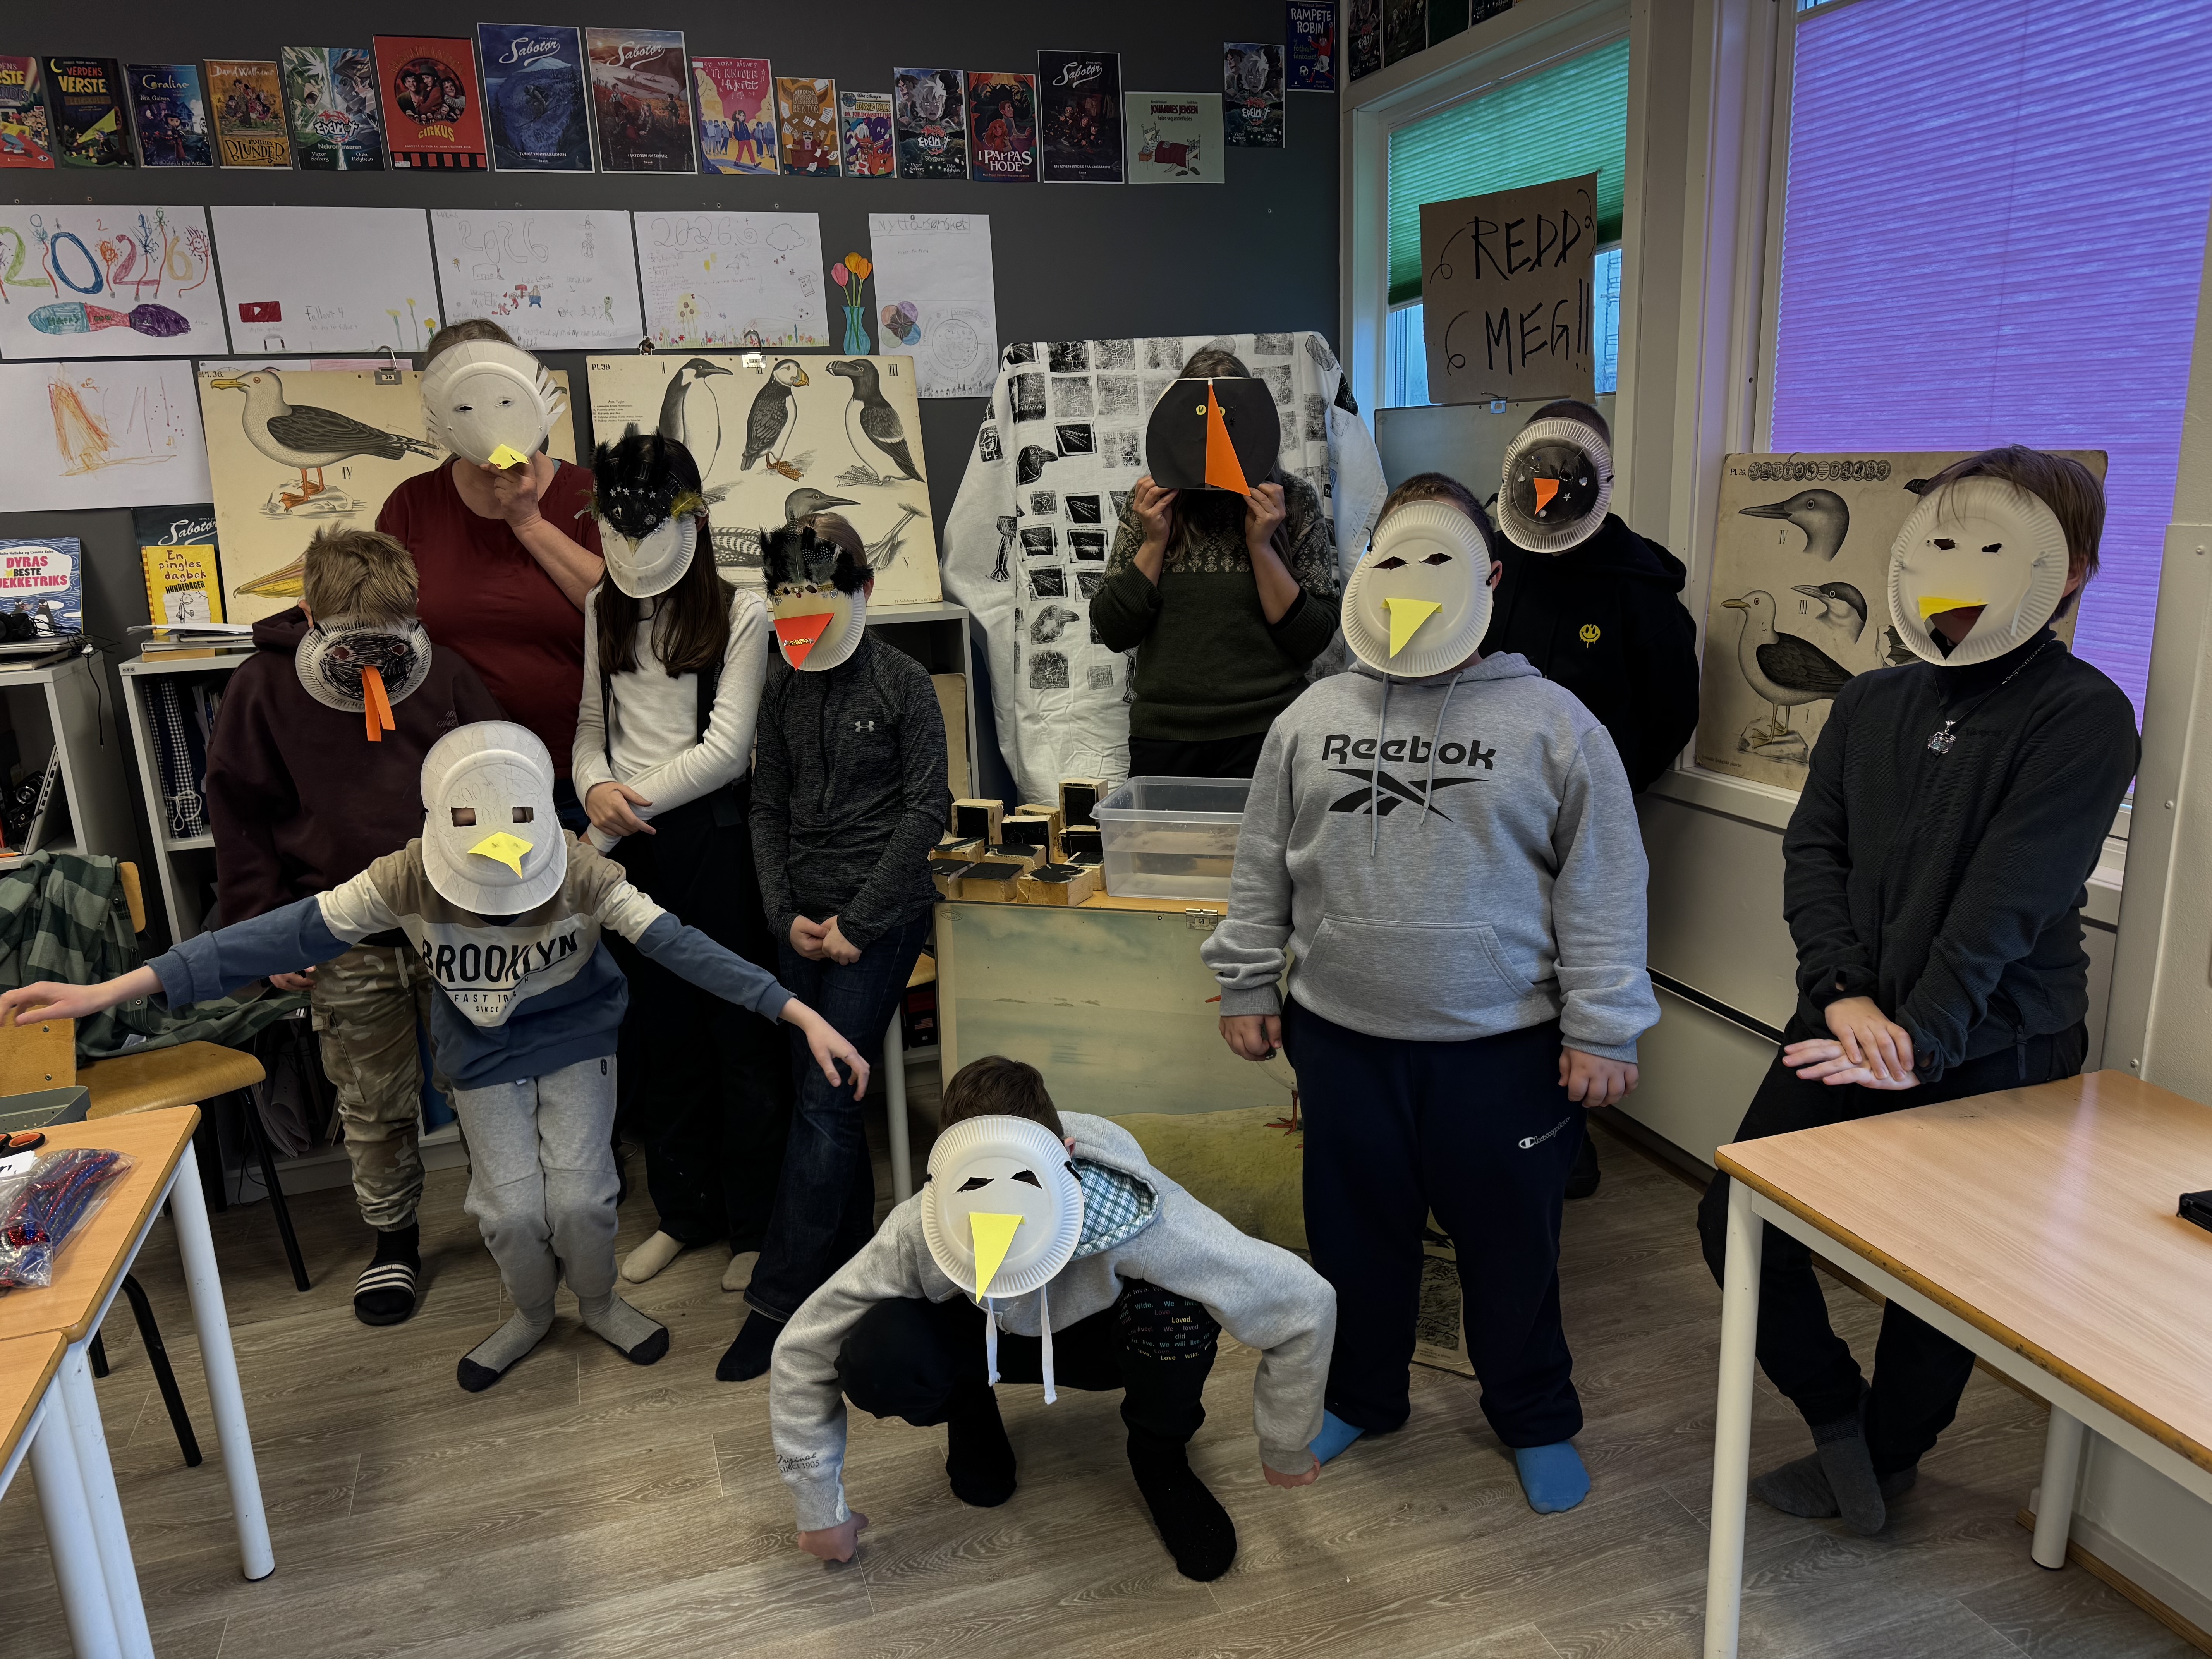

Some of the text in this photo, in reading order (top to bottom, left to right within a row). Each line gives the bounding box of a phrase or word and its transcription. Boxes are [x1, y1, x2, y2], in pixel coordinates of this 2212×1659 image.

[1291, 8, 1331, 22] RAMPETE
[1297, 21, 1324, 34] ROBIN
[499, 37, 560, 66] Sabotør
[606, 41, 665, 70] Sabotør
[66, 66, 102, 76] VERDENS
[725, 69, 758, 79] KNIVER
[1052, 62, 1103, 88] Sabotør
[58, 76, 107, 93] VERSTE
[142, 74, 190, 89] Coraline
[725, 79, 759, 91] hjertet
[793, 94, 818, 104] VERSTE
[793, 104, 819, 113] REKTOR
[1151, 105, 1198, 115] JOHANNES JENSEN
[418, 125, 455, 142] CIRKUS
[224, 140, 285, 162] BLUNDER
[979, 150, 1032, 165] I PAPPAS
[990, 161, 1023, 172] HODE
[1467, 209, 1581, 281] REDD
[305, 305, 335, 321] Fallout
[1486, 278, 1589, 375] MEG!!
[888, 364, 898, 376] III
[341, 467, 353, 480] IV
[1779, 530, 1788, 545] IV
[167, 550, 184, 560] En
[6, 556, 48, 568] DYRAS
[159, 558, 201, 571] pingles
[14, 568, 41, 577] BESTE
[165, 569, 206, 582] dagbok
[165, 580, 205, 594] HUNDEDAGER
[1799, 600, 1808, 615] III
[1321, 734, 1496, 770] Reebok
[422, 929, 578, 982] BROOKLYN
[454, 994, 488, 1002] FAST
[802, 1460, 820, 1469] 1905
